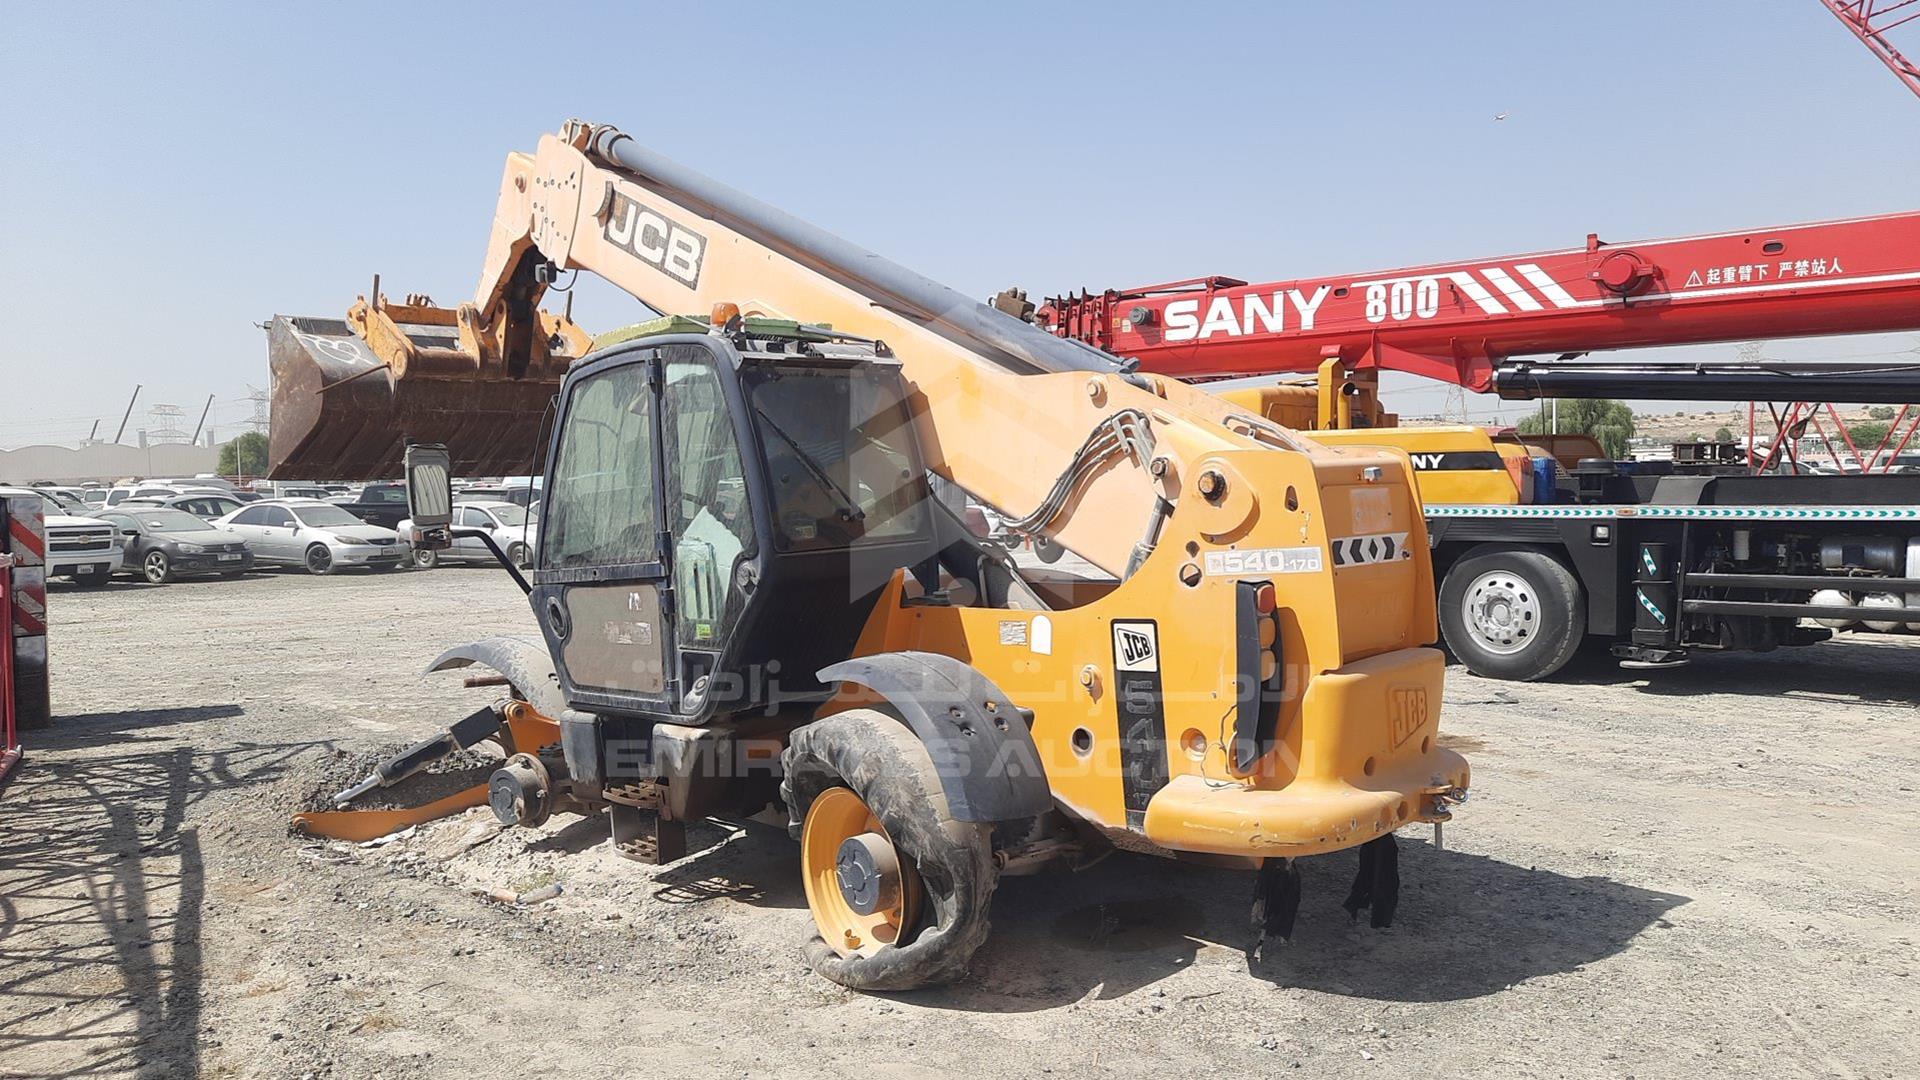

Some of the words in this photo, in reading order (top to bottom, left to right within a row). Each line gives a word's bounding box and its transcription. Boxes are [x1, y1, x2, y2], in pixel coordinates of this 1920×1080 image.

[608, 203, 701, 282] JCB
[1706, 264, 1768, 284] 起重臂下
[1778, 257, 1843, 279] 严禁站人
[1164, 285, 1332, 341] SANY
[1366, 279, 1439, 323] 800
[1123, 632, 1151, 661] JCB
